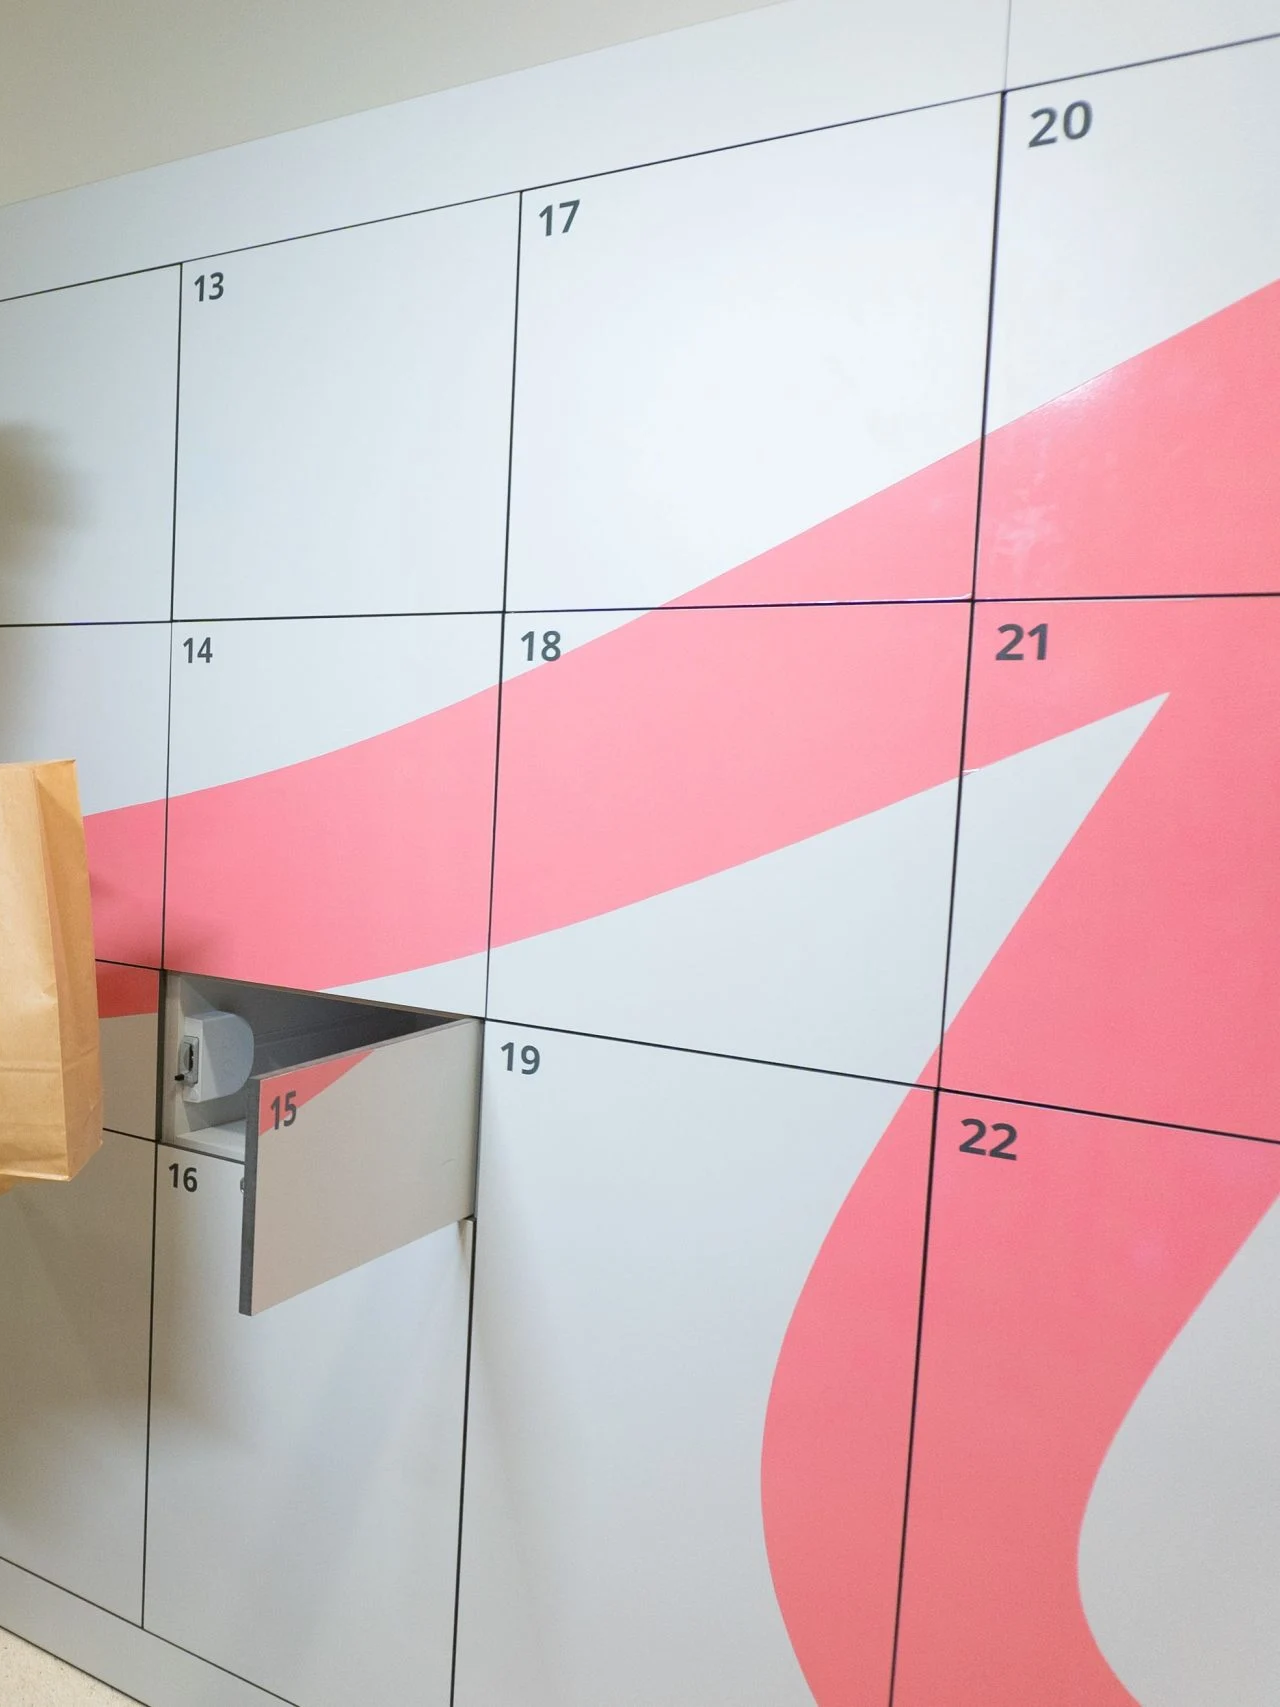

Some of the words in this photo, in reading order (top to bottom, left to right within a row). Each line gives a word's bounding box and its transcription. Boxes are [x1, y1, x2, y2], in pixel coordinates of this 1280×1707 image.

[1028, 100, 1092, 148] 20
[538, 199, 580, 237] 17
[194, 271, 224, 302] 13
[183, 636, 213, 664] 14
[520, 630, 561, 662] 18
[995, 623, 1048, 661] 21
[500, 1041, 541, 1075] 19
[270, 1090, 297, 1130] 15
[958, 1118, 1018, 1161] 22
[168, 1162, 198, 1193] 16
